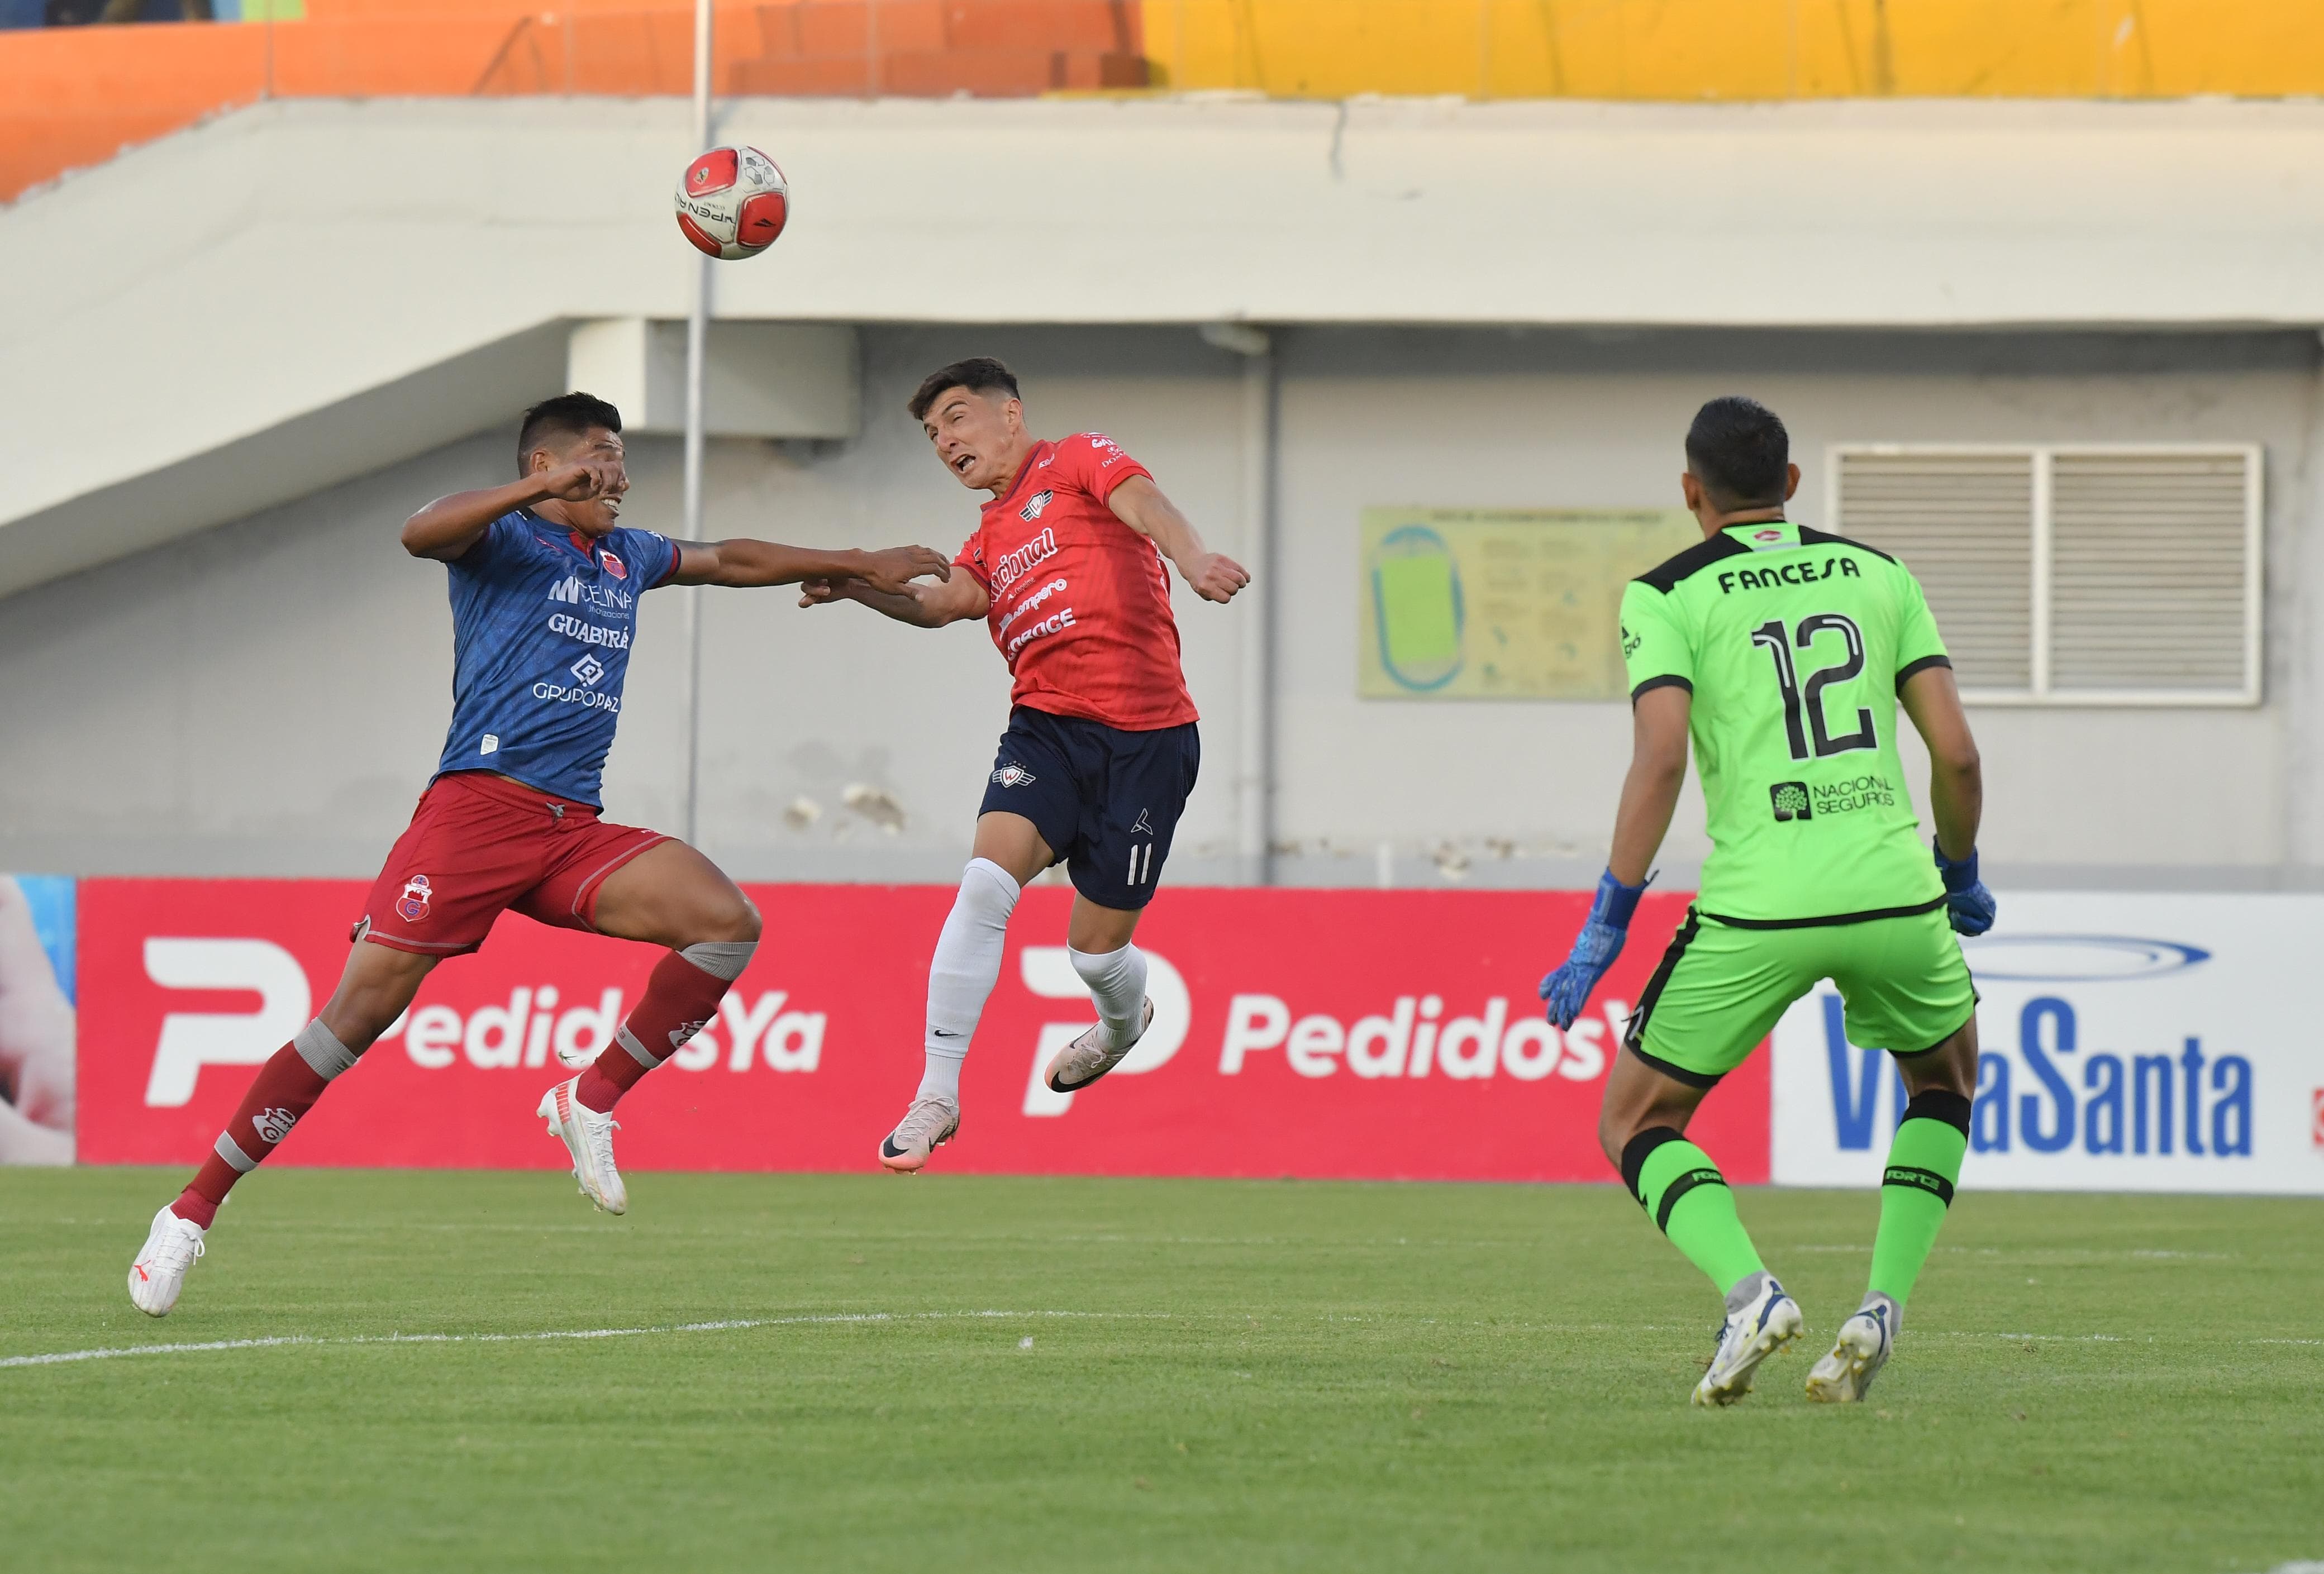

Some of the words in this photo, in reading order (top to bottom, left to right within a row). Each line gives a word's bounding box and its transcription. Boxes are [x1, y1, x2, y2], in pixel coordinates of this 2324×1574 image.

[990, 527, 1059, 603] acional
[1718, 557, 1861, 594] FANCESA
[548, 613, 629, 650] GUABIRÁ
[1751, 613, 1878, 761] 12
[1004, 770, 1018, 781] W
[1127, 842, 1152, 886] 11
[405, 900, 420, 916] G
[376, 985, 827, 1072] edidsYa
[1822, 995, 2252, 1158] VaSanta
